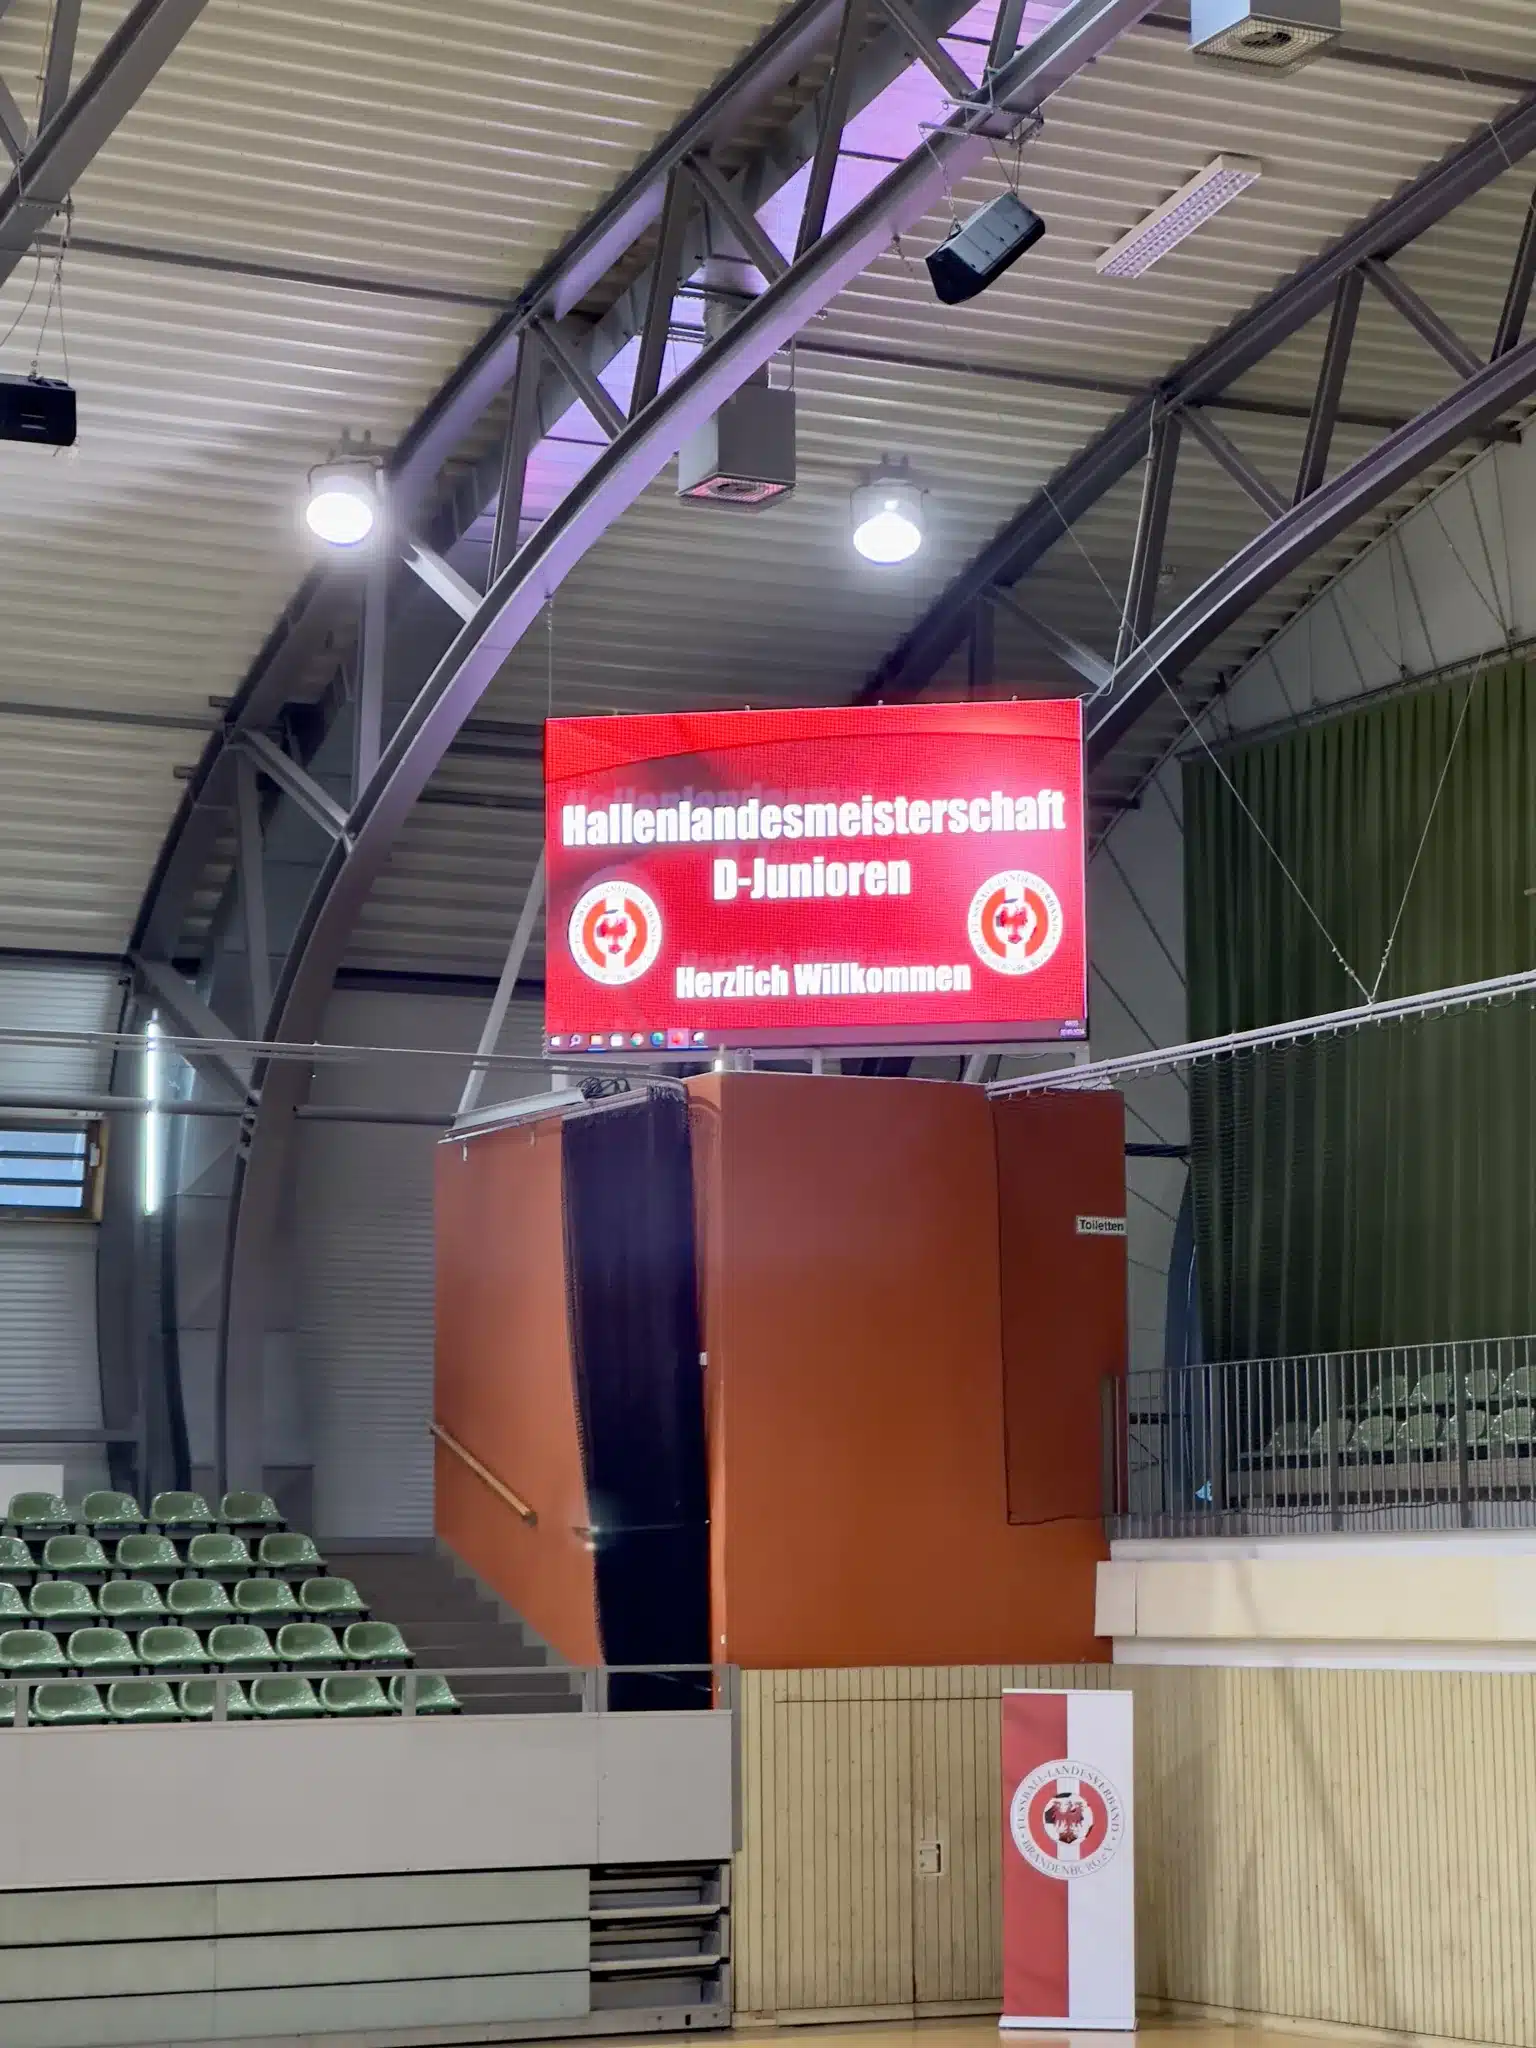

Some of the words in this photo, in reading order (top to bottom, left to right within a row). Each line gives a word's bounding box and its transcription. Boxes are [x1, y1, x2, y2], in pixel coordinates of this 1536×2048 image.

[562, 790, 1067, 846] Hallenlandesmeisterschaft
[713, 858, 911, 901] D-Junioren
[675, 966, 789, 1000] Herzlich
[794, 962, 972, 996] Willkommen
[1079, 1219, 1125, 1232] Toiletten
